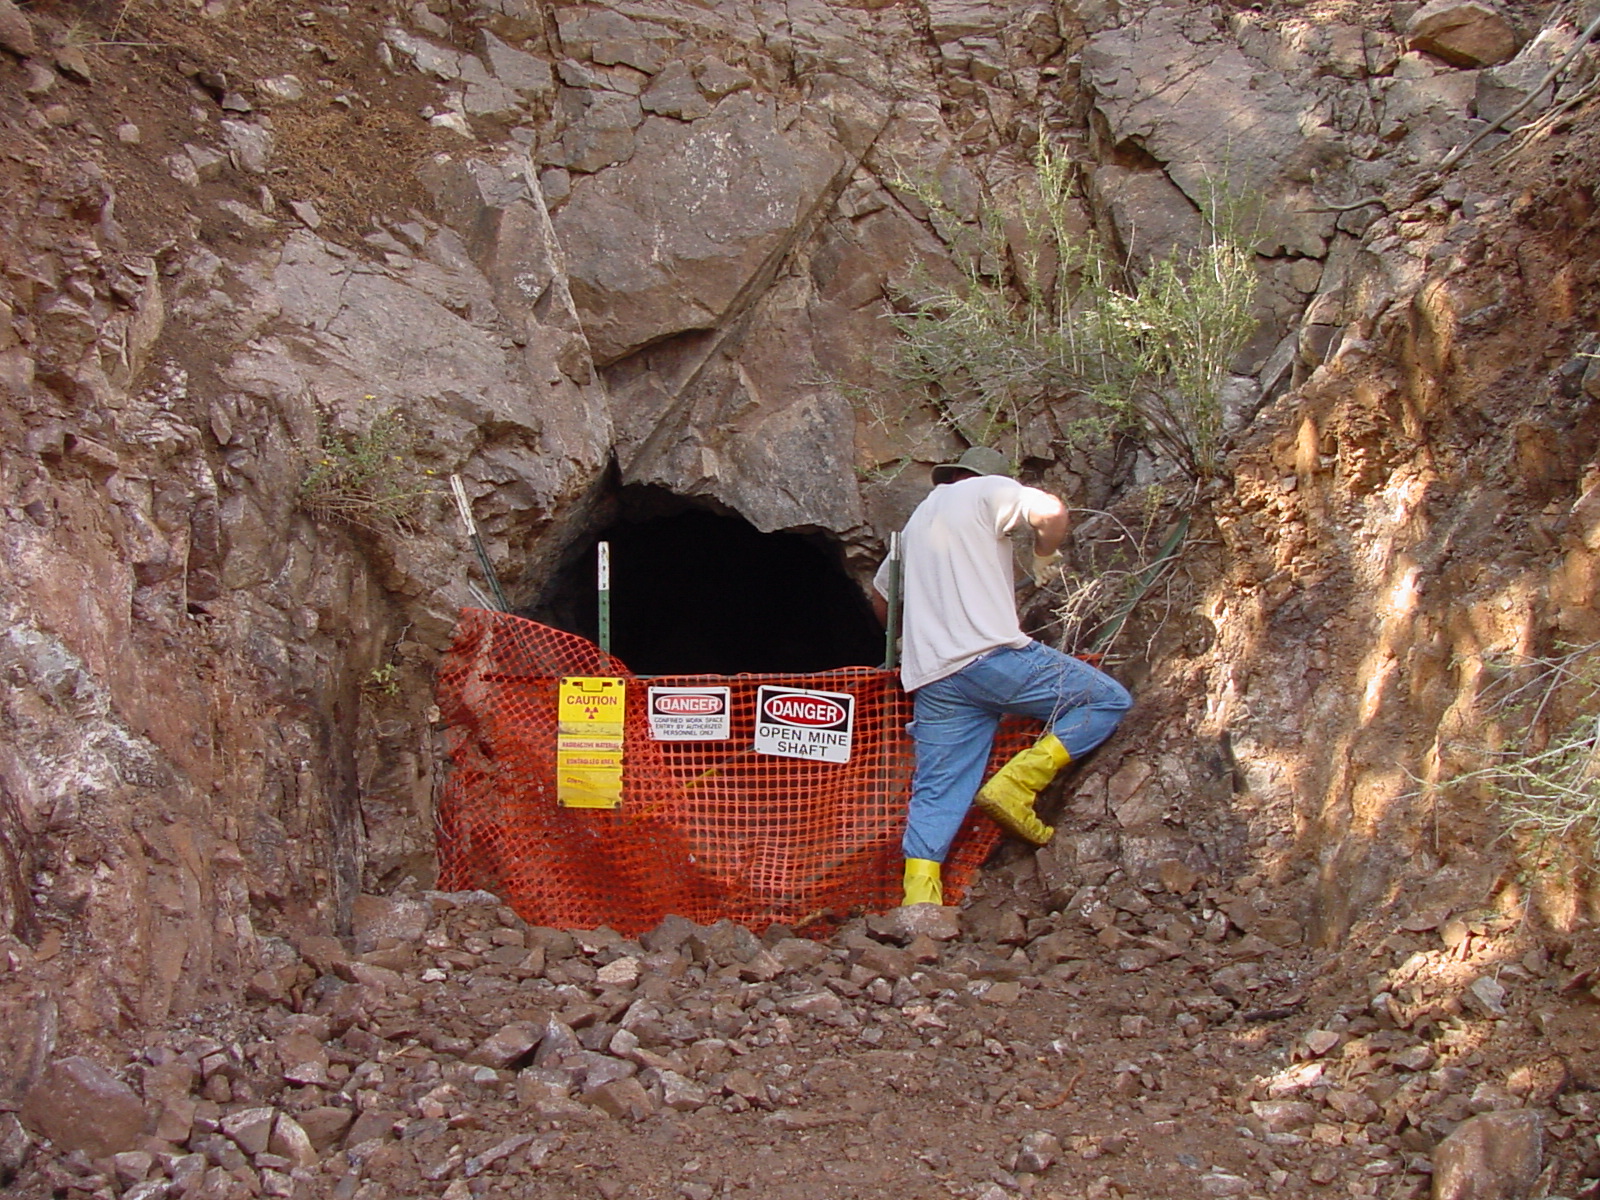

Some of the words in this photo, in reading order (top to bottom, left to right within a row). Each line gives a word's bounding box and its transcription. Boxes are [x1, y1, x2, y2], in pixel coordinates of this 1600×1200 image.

[566, 695, 618, 706] CAUTION
[660, 698, 719, 711] DANGER
[772, 700, 838, 722] DANGER
[760, 726, 802, 741] OPEN
[808, 731, 848, 747] MINE
[777, 741, 829, 757] SHAFT
